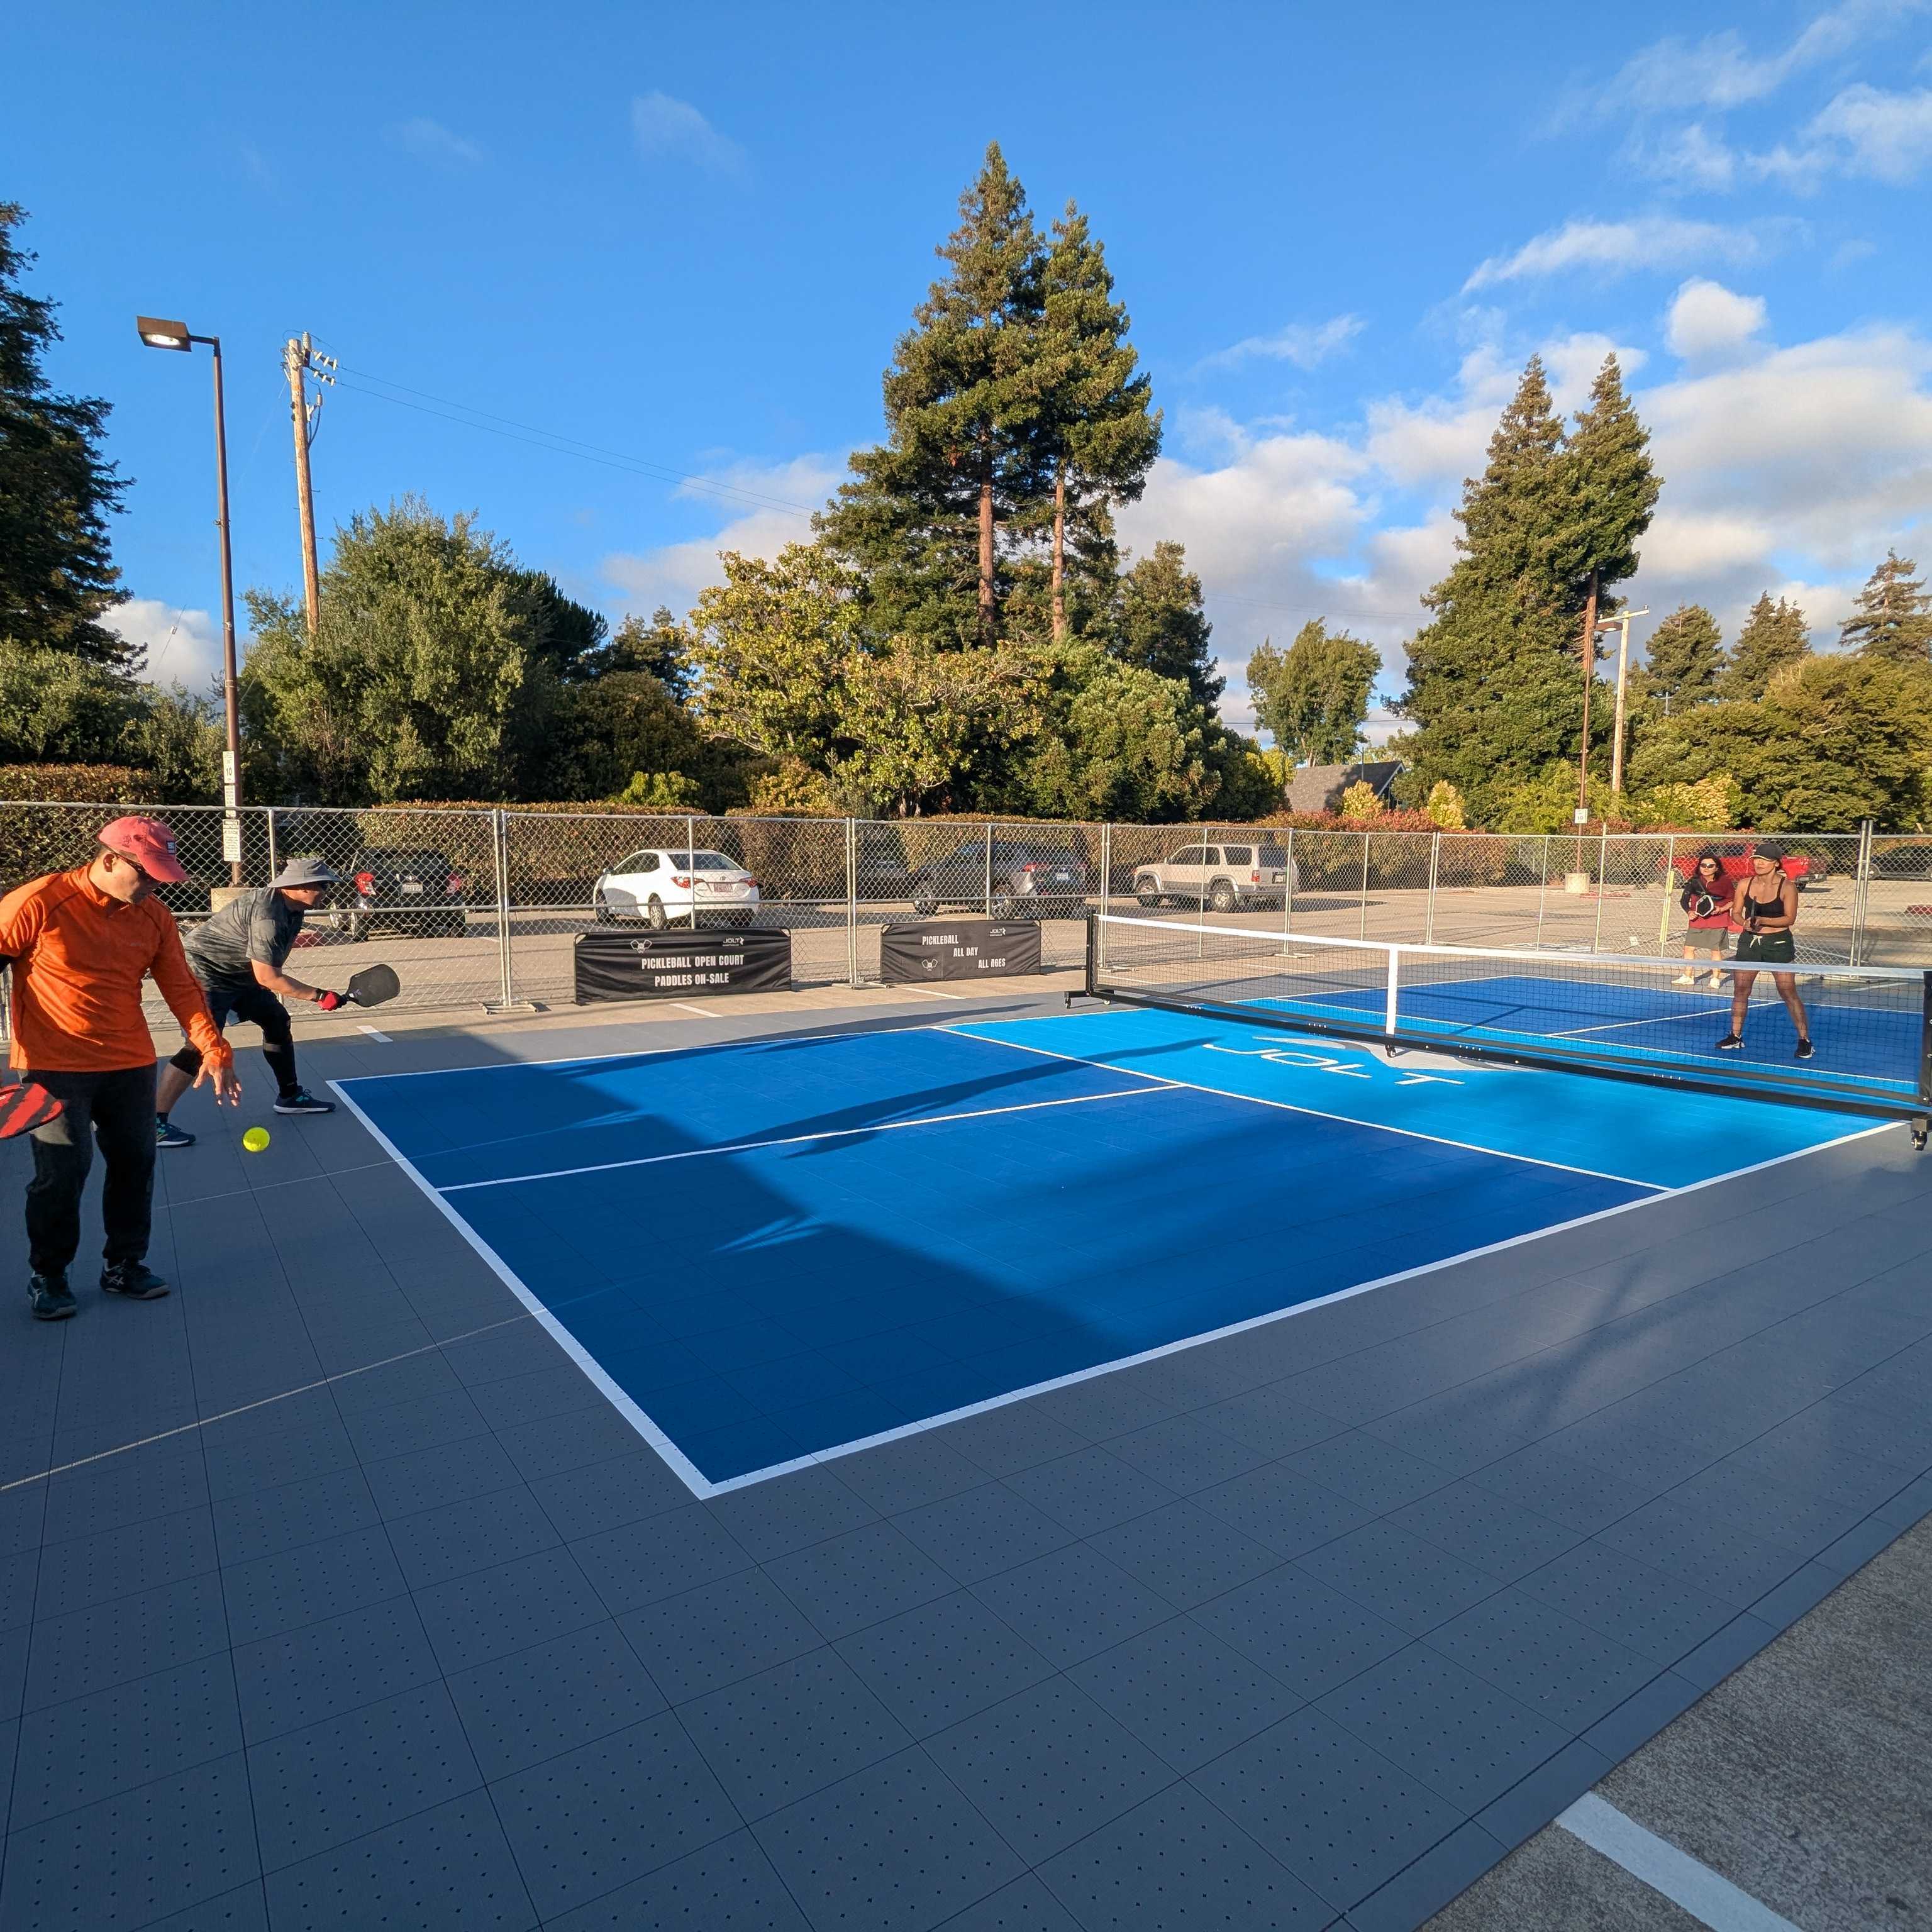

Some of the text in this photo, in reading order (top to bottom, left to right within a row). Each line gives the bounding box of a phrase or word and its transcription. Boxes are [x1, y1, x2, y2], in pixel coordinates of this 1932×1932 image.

[226, 767, 232, 776] 10
[922, 935, 959, 945] PICKLEBALL
[953, 947, 979, 957] ALL DAY
[641, 954, 745, 970] PICKLEBALL OPEN COURT
[978, 958, 1006, 969] ALL AGES
[654, 972, 730, 987] PADDLES ON-SALE
